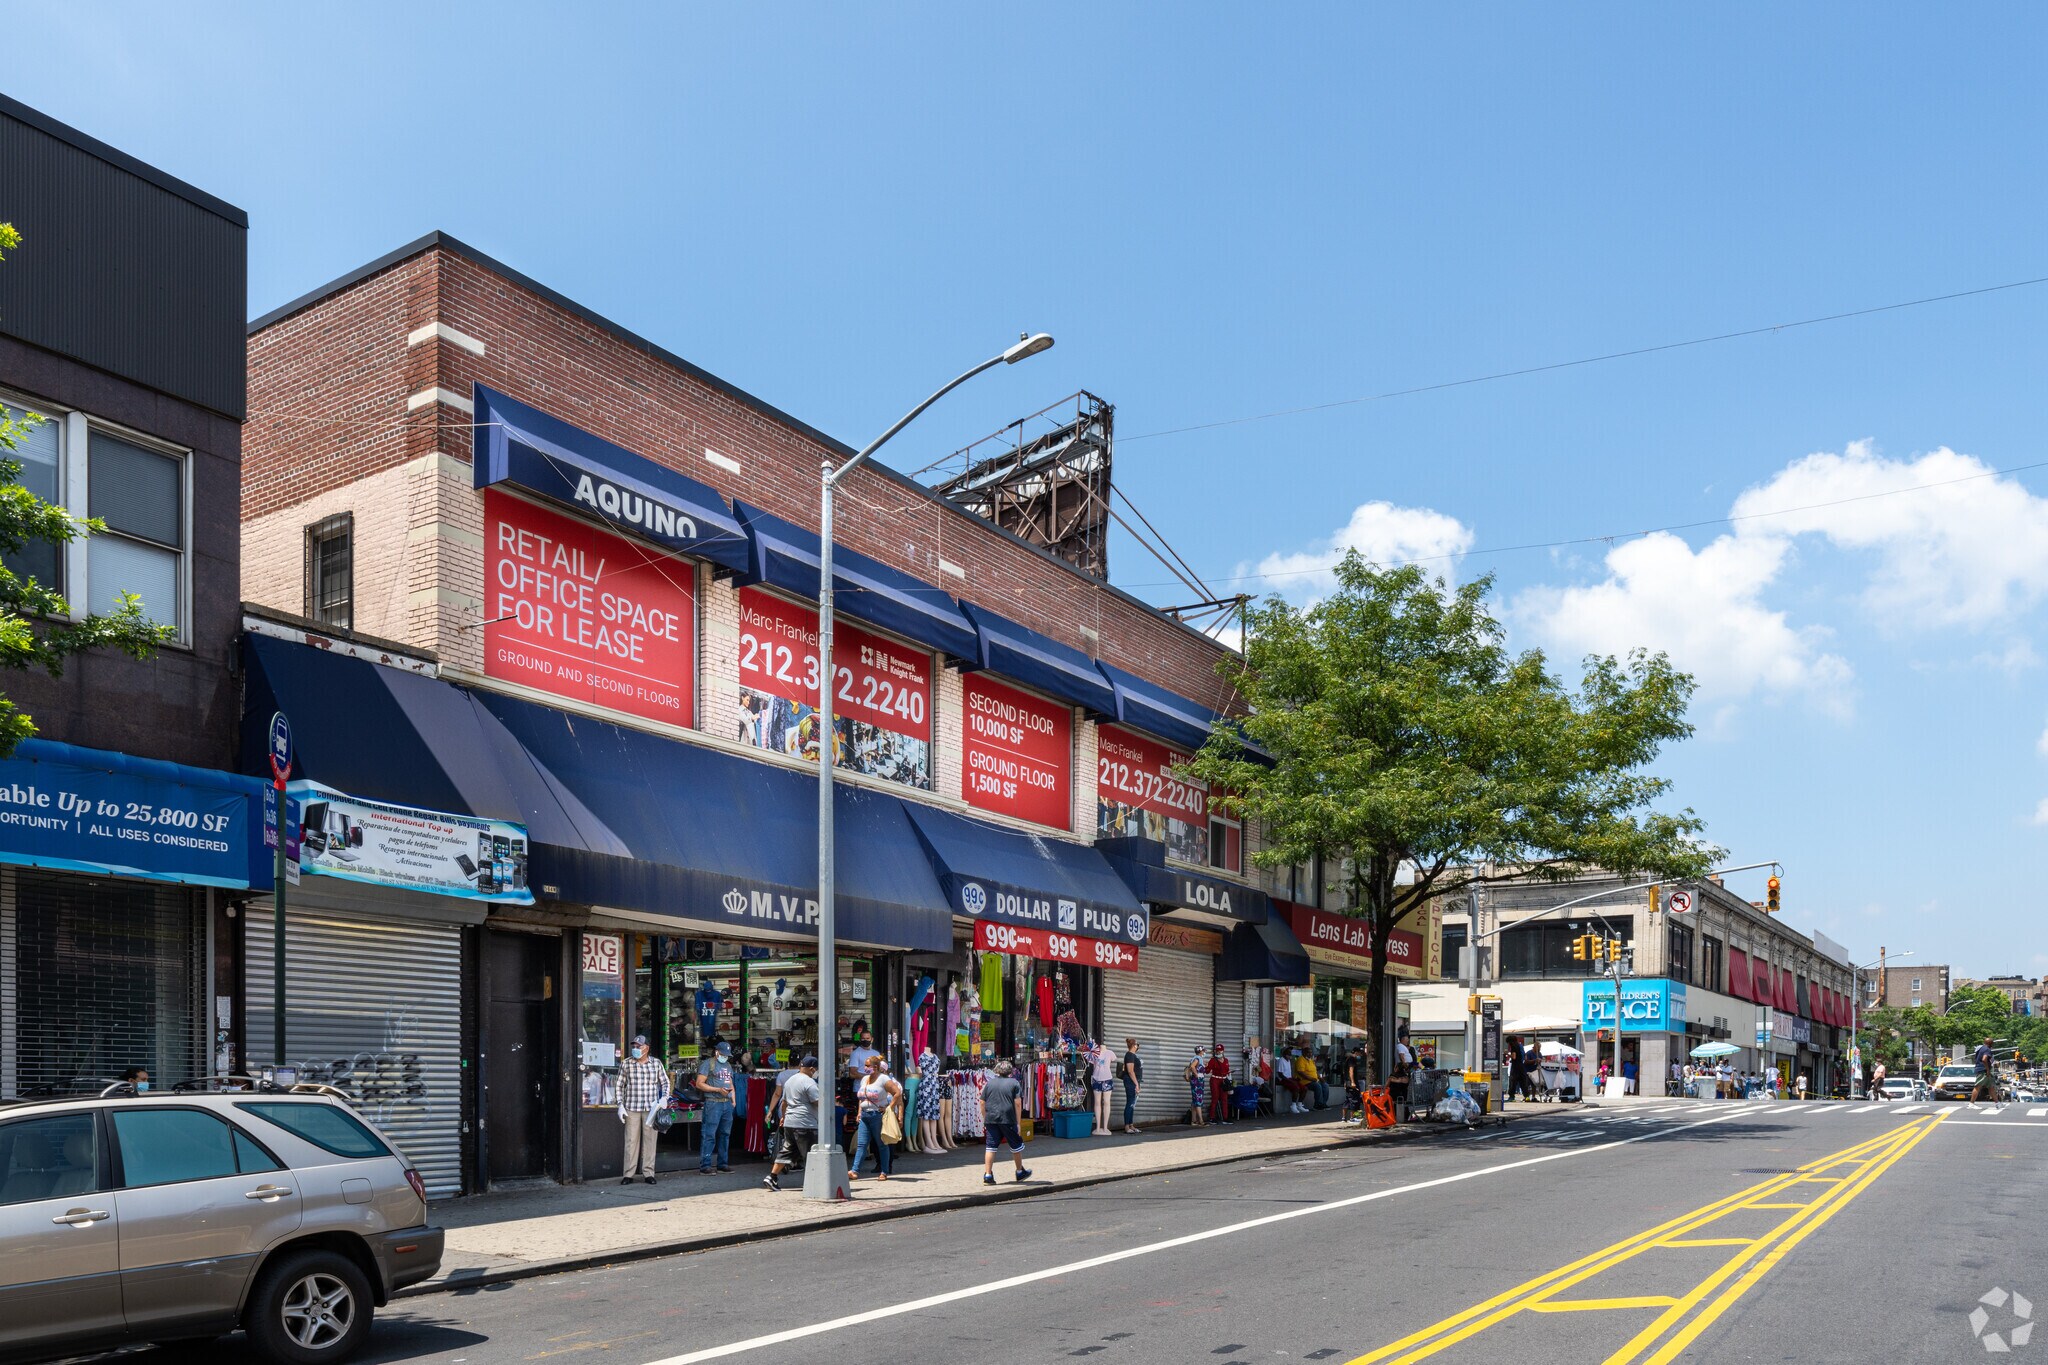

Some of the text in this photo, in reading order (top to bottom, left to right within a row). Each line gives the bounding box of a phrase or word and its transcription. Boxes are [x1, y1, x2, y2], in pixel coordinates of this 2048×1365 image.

[574, 474, 697, 538] AQUINO
[498, 521, 605, 585] RETAIL/
[498, 559, 679, 642] OFFICE SPACE
[498, 593, 644, 663] FOR LEASE
[740, 605, 819, 647] Marc Frankel
[498, 648, 680, 709] GROUND AND SECOND FLOORS
[740, 633, 924, 724] 212.32.2240
[890, 656, 916, 673] Newmark
[890, 667, 924, 684] Knight Frank
[969, 691, 1054, 736] SECOND FLOOR
[970, 713, 1024, 745] 10,000 SF
[969, 750, 1055, 791] GROUND FLOOR
[1100, 737, 1143, 763] Marc Frankel
[970, 772, 1017, 799] 1,500 SF
[1100, 757, 1203, 815] 212.372.2240
[0, 811, 229, 852] ORTUNITY ALL USES CONSIDERED
[57, 791, 92, 817] Up
[97, 800, 120, 817] to
[124, 802, 198, 829] 25,800
[202, 814, 230, 833] SF
[427, 822, 442, 833] Top
[443, 827, 454, 835] up
[440, 814, 457, 825] Bills
[458, 819, 491, 832] payments
[378, 843, 448, 862] Recargas internacionales
[388, 836, 405, 847] pagos
[414, 841, 438, 851] telefonos
[401, 829, 440, 841] computadoras
[396, 857, 432, 869] Activaciones
[964, 886, 984, 905] 99¢
[996, 892, 1051, 922] DOLLAR
[1083, 908, 1120, 934] PLUS
[1128, 918, 1143, 934] 99¢
[1186, 881, 1232, 913] LOLA
[583, 937, 617, 957] BIG
[985, 924, 1017, 949] 99¢
[1017, 935, 1025, 944] And
[1026, 936, 1032, 945] Up
[1048, 934, 1078, 959] 99¢
[1095, 941, 1121, 965] 99¢
[1311, 915, 1409, 957] Lens Lab Eress
[1324, 951, 1332, 960] Eye
